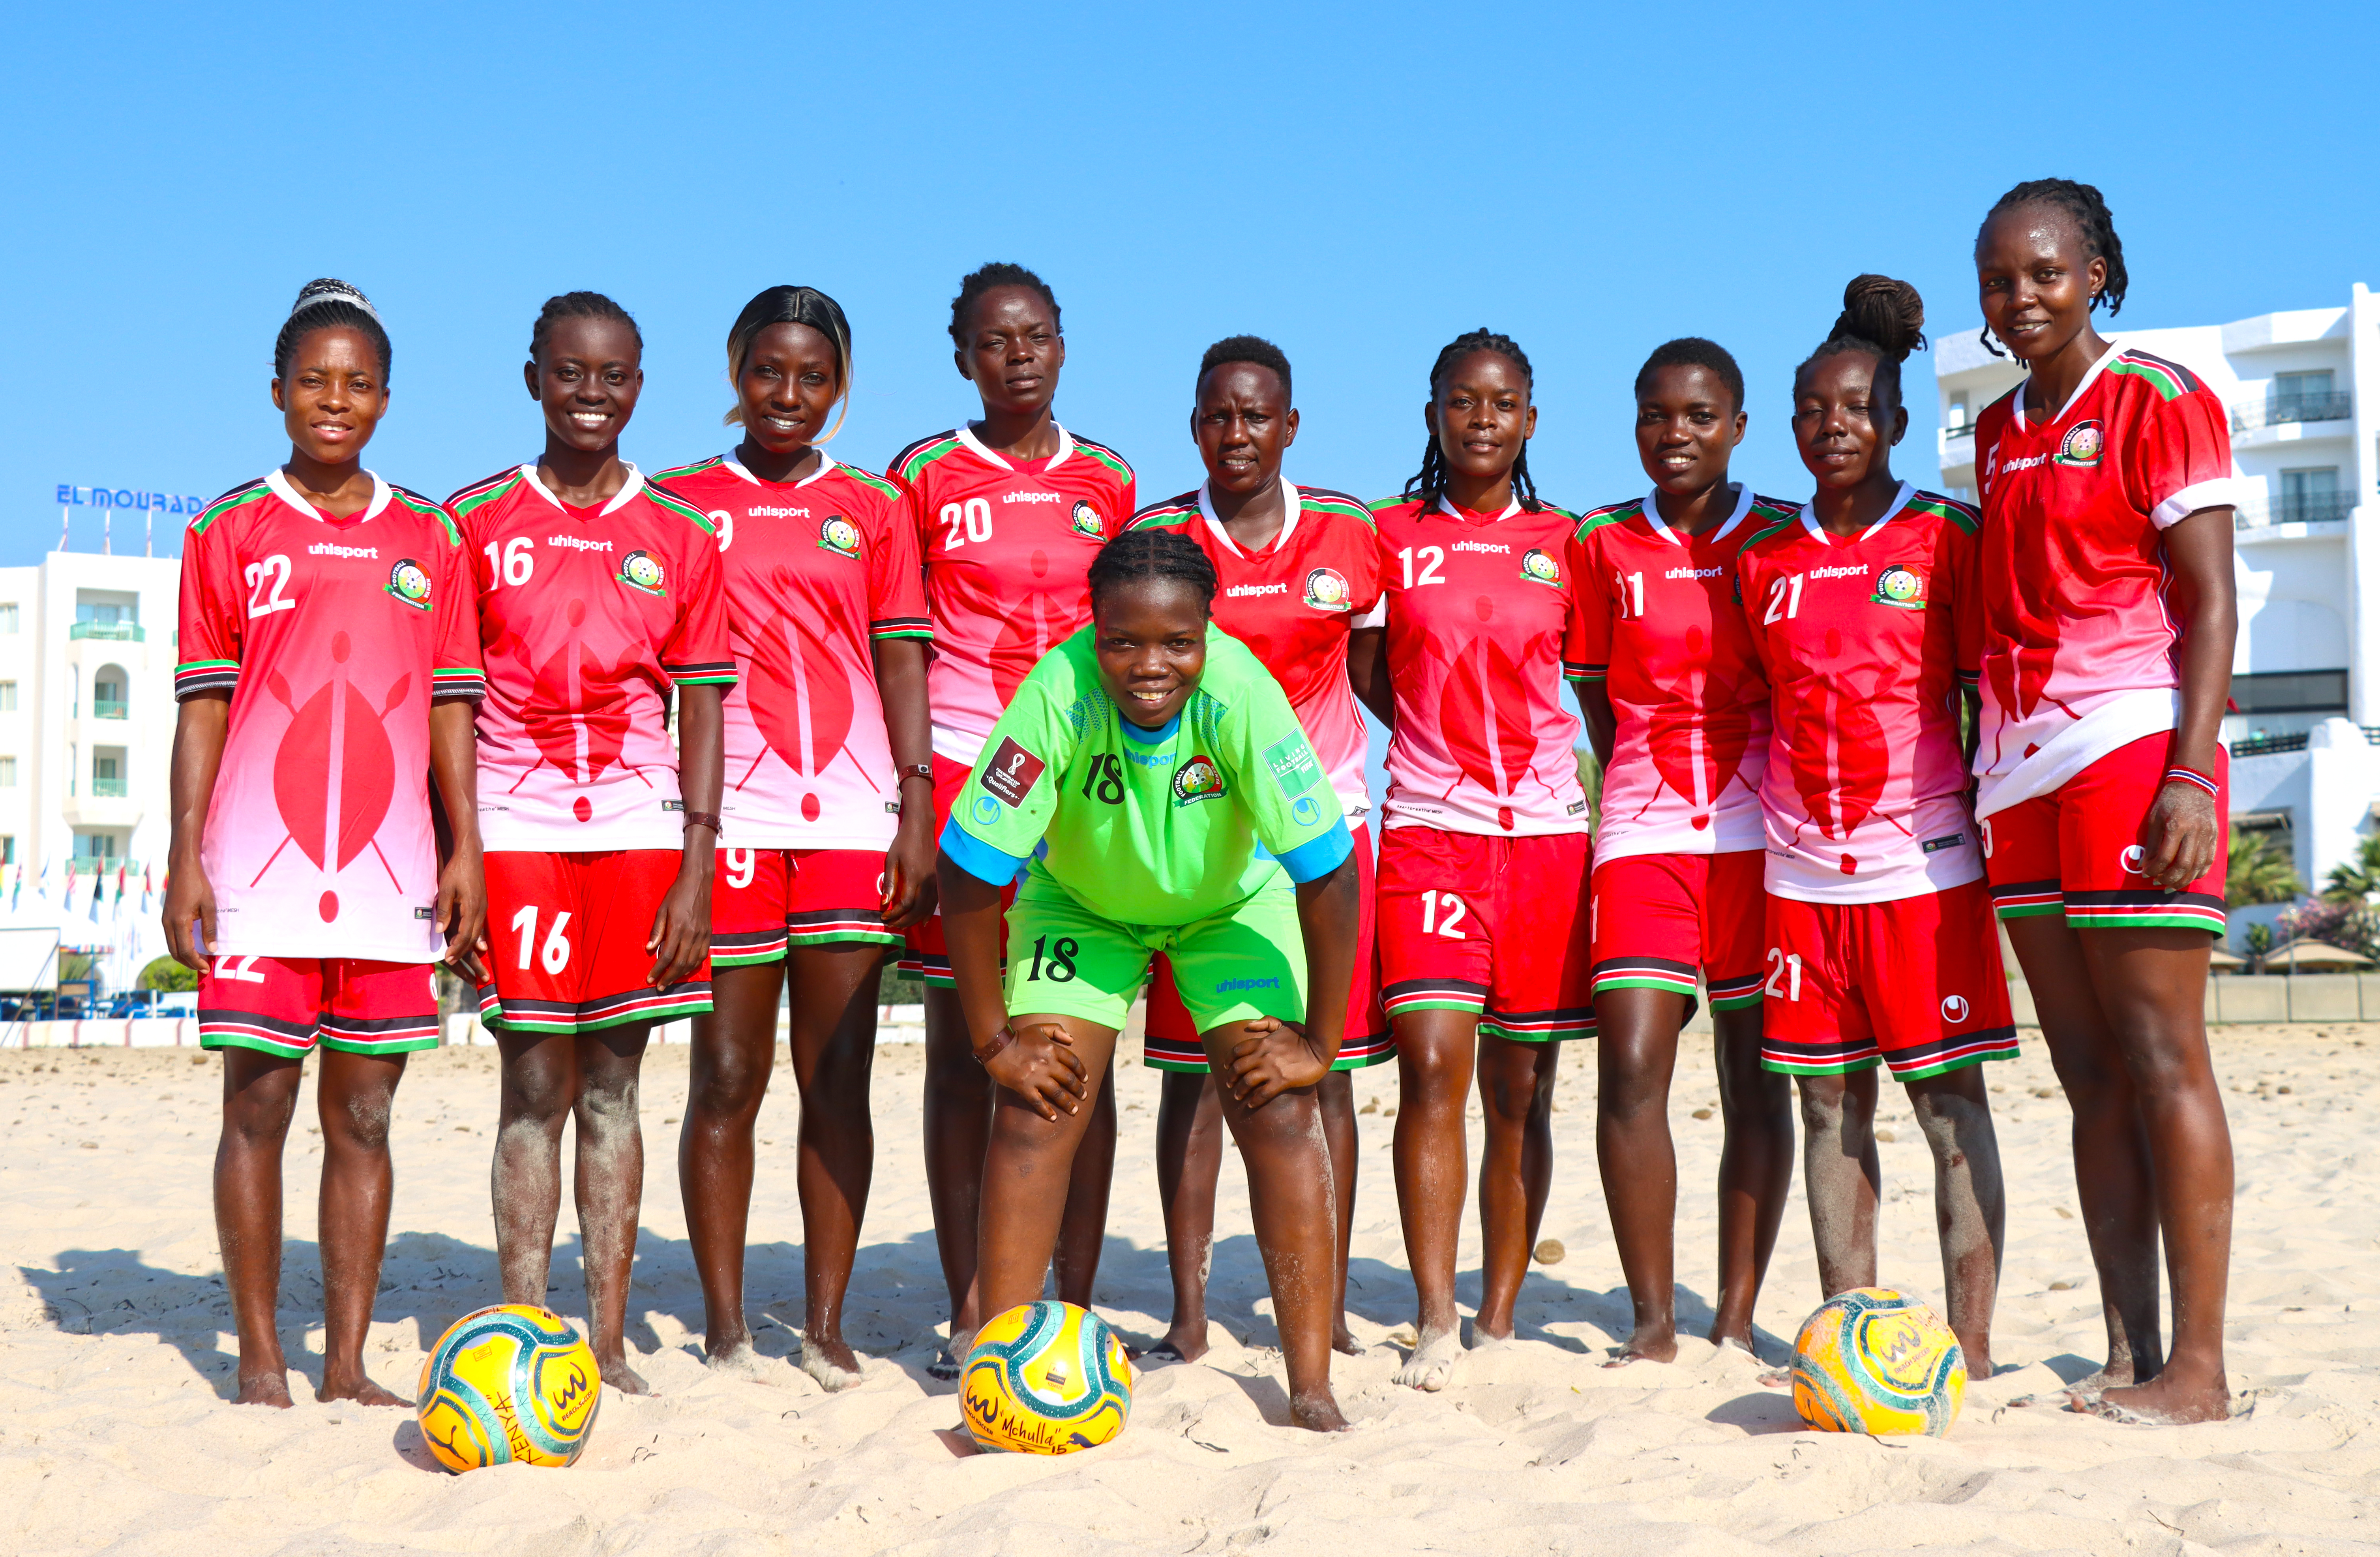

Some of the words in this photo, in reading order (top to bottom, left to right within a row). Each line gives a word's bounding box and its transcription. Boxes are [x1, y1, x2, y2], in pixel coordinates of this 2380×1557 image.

[2063, 428, 2080, 455] FOOTBALL
[2002, 453, 2046, 474] uhlsport
[57, 484, 84, 505] EL
[92, 488, 210, 514] MOURAD
[1003, 490, 1061, 505] uhlsport
[749, 506, 810, 518] uhlsport
[823, 518, 833, 542] FOOTBALL
[940, 498, 993, 551] 20
[308, 543, 378, 559] uhlsport
[549, 535, 613, 552] uhlsport
[827, 544, 855, 558] FEDERATION
[1452, 540, 1510, 554] uhlsport
[392, 561, 406, 587] FOOTBALL
[484, 537, 534, 591] 16
[624, 553, 637, 577] FOOTBALL
[1399, 546, 1445, 589] 12
[1524, 552, 1533, 574] FOOTBALL
[1666, 565, 1722, 580] uhlsport
[1810, 563, 1868, 579] uhlsport
[245, 554, 295, 619] 22
[626, 580, 658, 595] FEDERATION
[1227, 583, 1287, 597] uhlsport
[1308, 573, 1317, 598] FOOTBALL
[1529, 576, 1558, 587] FEDERATION
[1879, 569, 1893, 595] FOOTBALL
[392, 591, 424, 609] FEDERATION
[1764, 573, 1803, 625] 21
[1880, 599, 1915, 608] FEDERATION
[1125, 748, 1176, 769] hlspor
[1273, 743, 1305, 767] LIVING
[1276, 750, 1308, 773] FOOTBALL
[1003, 772, 1014, 782] WORLD
[1211, 765, 1220, 784] KENYA
[1301, 760, 1314, 773] FIFA
[988, 776, 1016, 798] Qualifiers
[1082, 752, 1125, 805] 18
[1175, 770, 1186, 797] FOOTBALL
[1184, 793, 1222, 805] FEDERATION
[726, 848, 755, 888] 9
[1421, 890, 1465, 939] 12
[512, 905, 572, 975] 16
[1027, 934, 1079, 982] 18
[1216, 976, 1280, 993] uhlsport
[1765, 947, 1802, 1002] 21
[1895, 1359, 1913, 1373] BEACH
[1912, 1347, 1930, 1362] SOCCER
[964, 1404, 975, 1421] BEACH
[976, 1418, 993, 1435] SOCCER
[1052, 1444, 1067, 1455] 15
